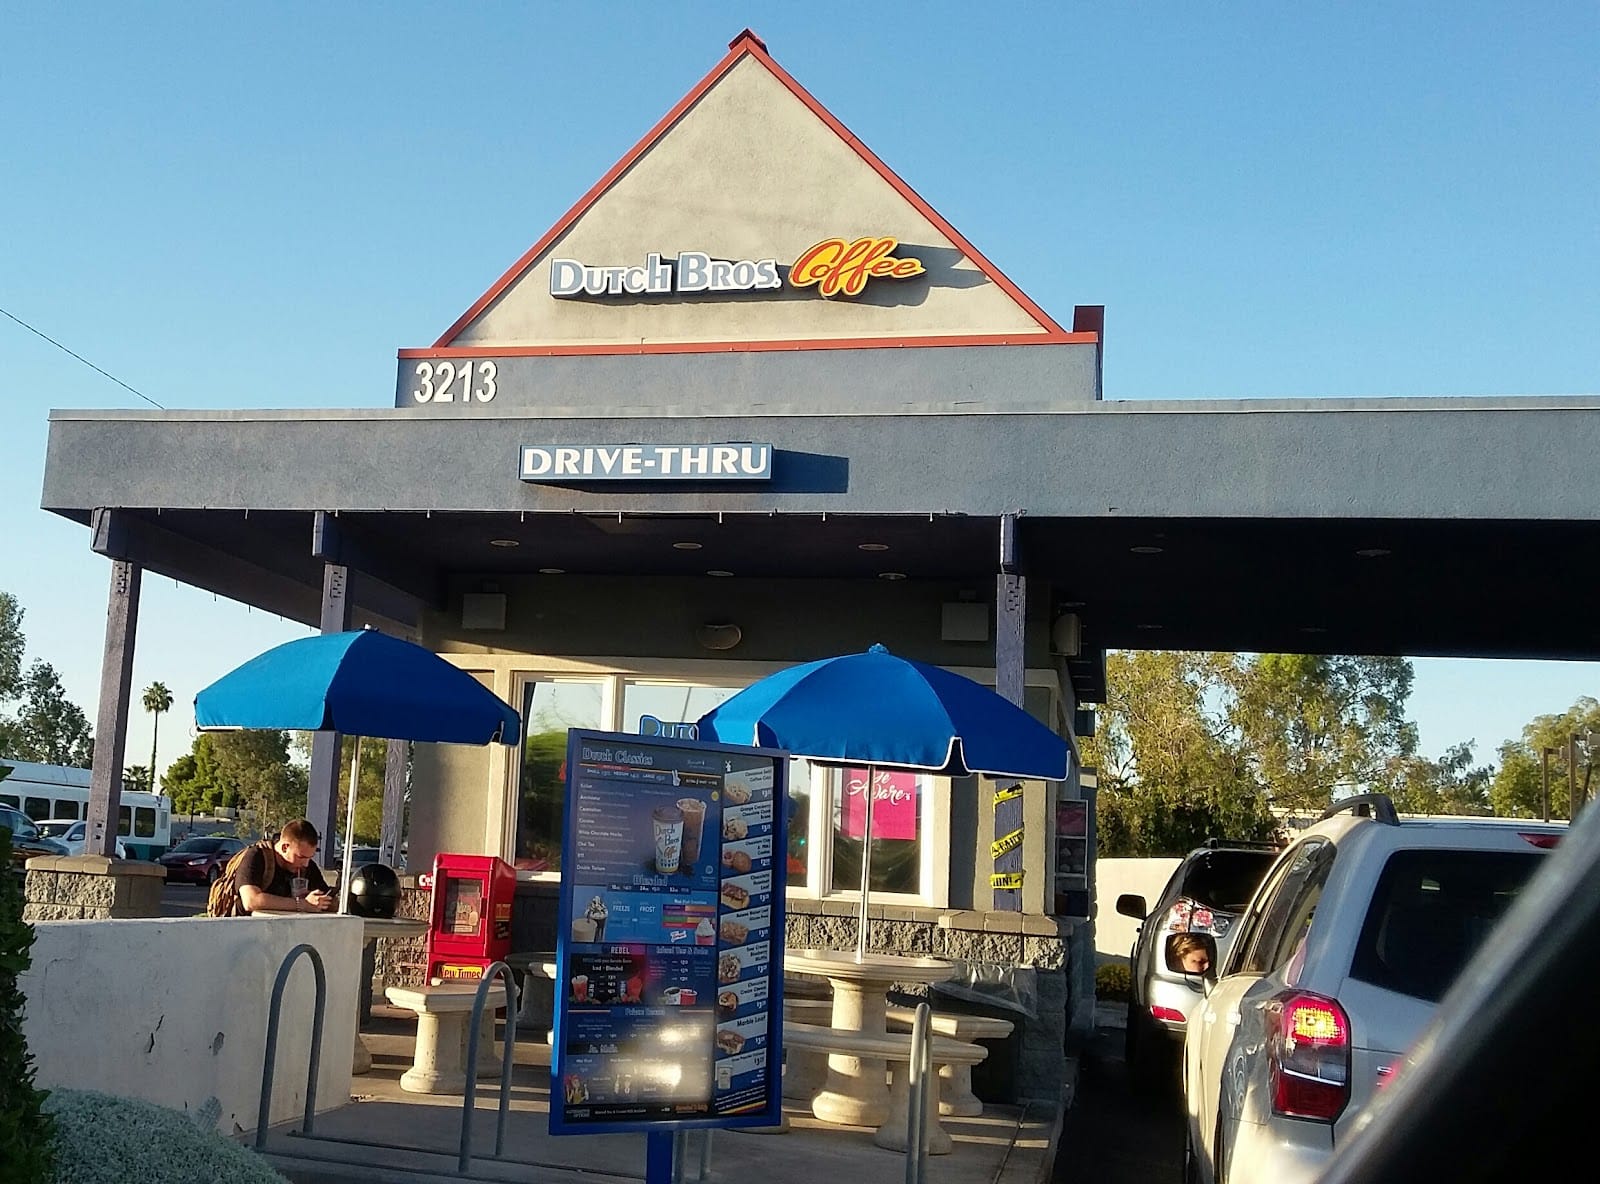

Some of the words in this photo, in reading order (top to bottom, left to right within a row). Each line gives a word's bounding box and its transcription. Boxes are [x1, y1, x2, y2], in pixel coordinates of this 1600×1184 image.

[789, 237, 925, 299] Coffee
[413, 360, 498, 404] 3213
[522, 445, 768, 477] DRIVE-THRU
[612, 904, 631, 912] FREEZE
[610, 946, 630, 954] REBEL
